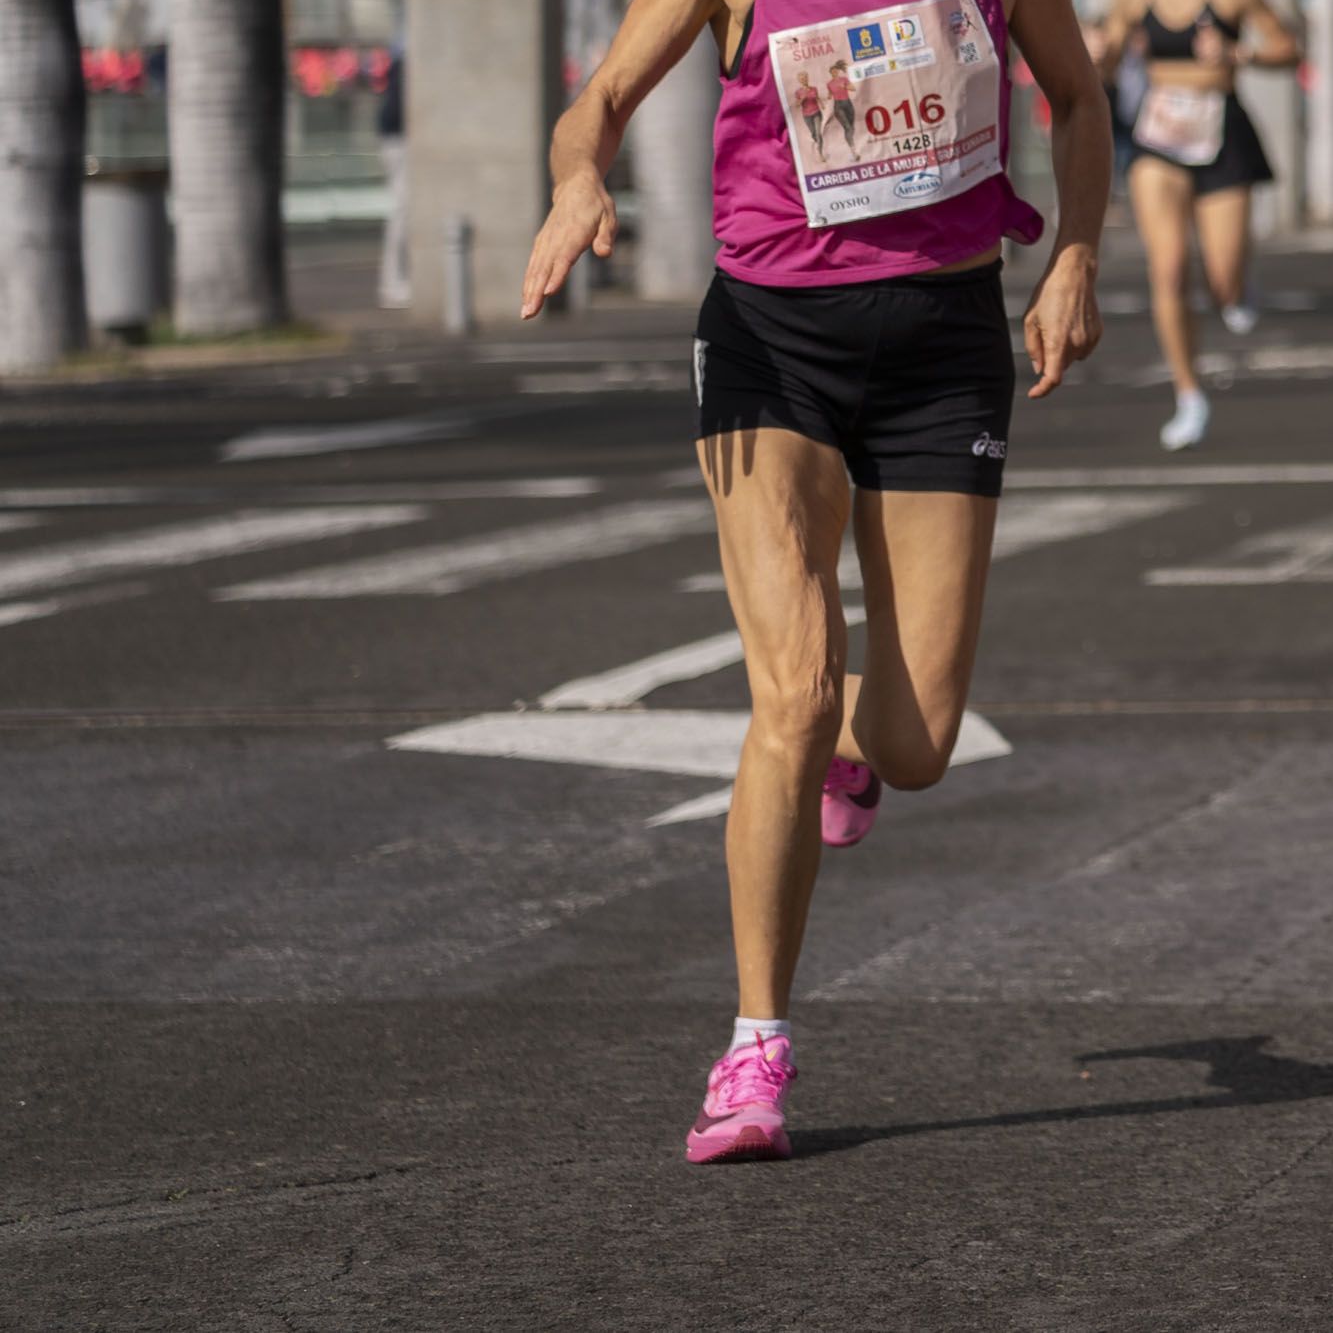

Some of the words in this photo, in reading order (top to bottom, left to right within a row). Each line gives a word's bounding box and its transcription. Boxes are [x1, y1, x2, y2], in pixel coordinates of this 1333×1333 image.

[793, 42, 834, 61] SUMA
[865, 93, 945, 136] 016
[893, 134, 932, 155] 1428
[811, 168, 858, 190] CARRERA
[860, 164, 873, 180] DE
[876, 161, 891, 175] LA
[893, 154, 928, 173] MUJER
[830, 195, 870, 211] OYSHO
